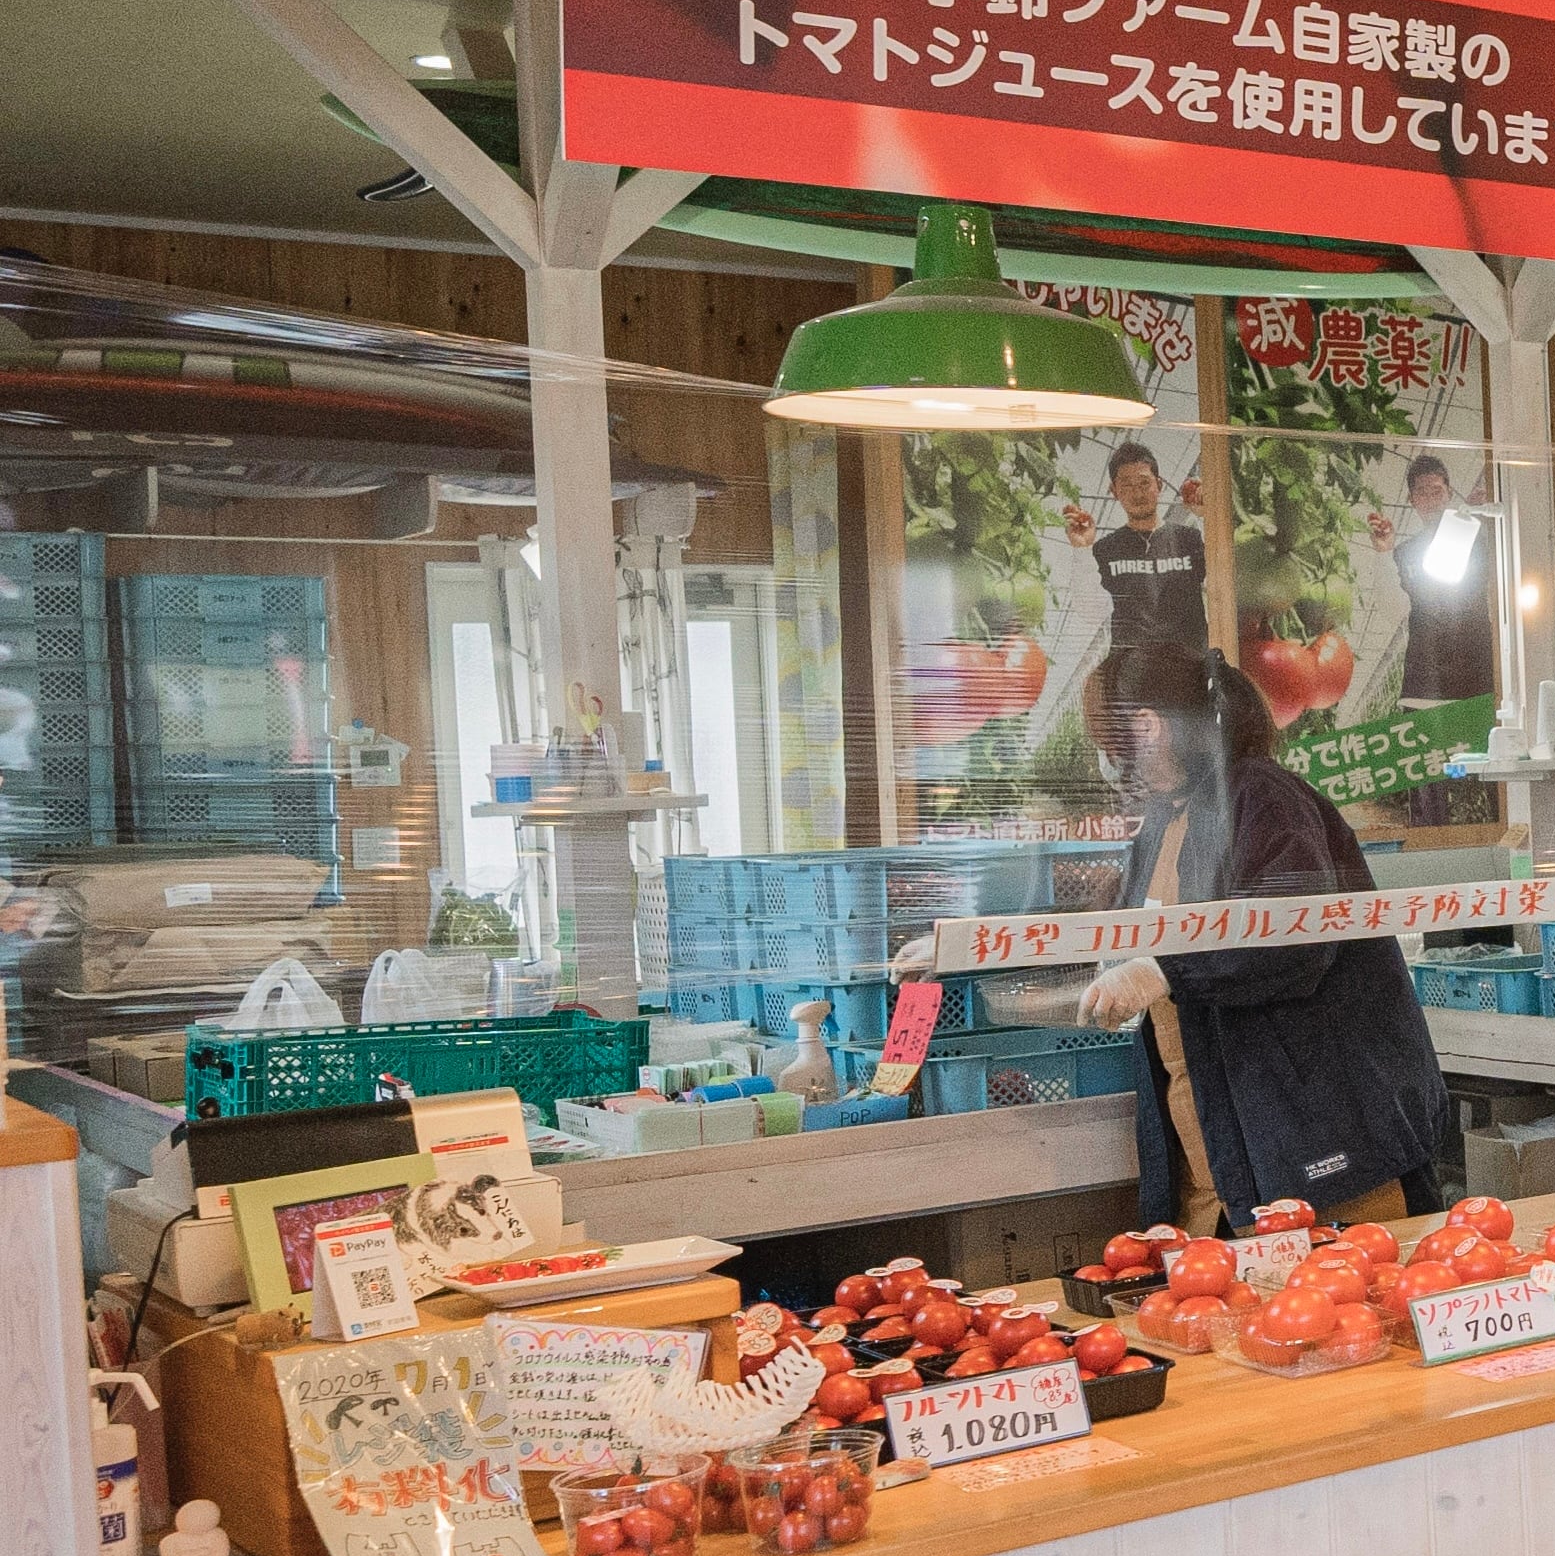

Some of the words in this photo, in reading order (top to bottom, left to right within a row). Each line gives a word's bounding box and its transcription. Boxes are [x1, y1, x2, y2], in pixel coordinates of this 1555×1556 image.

[1108, 559, 1155, 577] THREE
[1156, 555, 1192, 574] DICE
[840, 1107, 872, 1126] POP
[345, 1237, 387, 1253] PayPay
[1417, 1280, 1547, 1326] ソプラノトマト
[1464, 1310, 1534, 1342] 700円
[299, 1369, 387, 1402] 2020年
[895, 1378, 1027, 1422] フルーツトマト
[326, 1456, 521, 1518] 有料化
